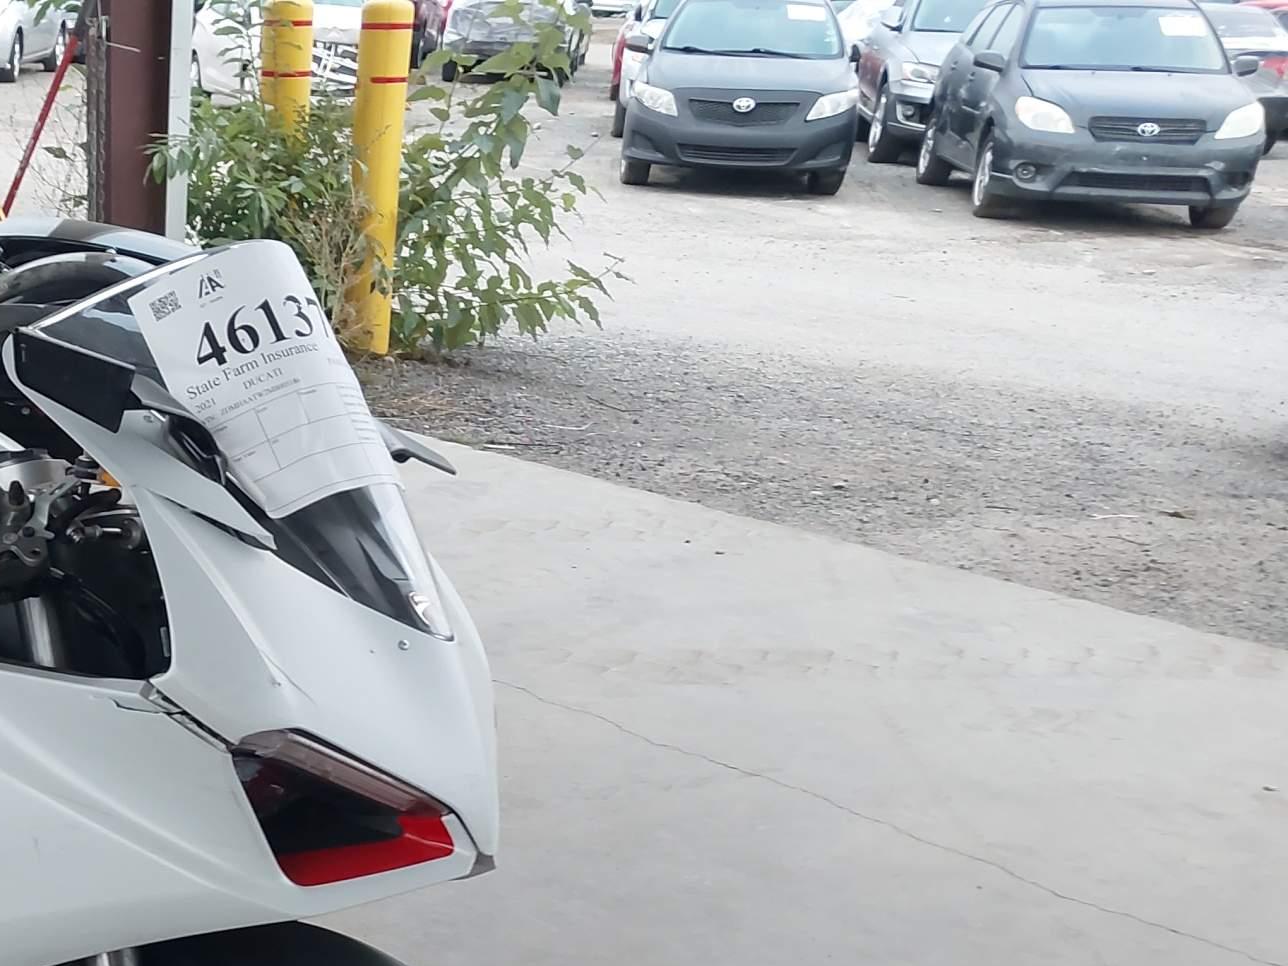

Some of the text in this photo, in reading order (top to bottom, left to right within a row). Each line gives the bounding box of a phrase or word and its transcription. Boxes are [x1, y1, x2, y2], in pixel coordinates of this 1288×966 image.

[186, 376, 221, 400] State
[222, 359, 260, 381] Farm
[261, 342, 319, 365] Insurance
[242, 367, 284, 390] DUCATI
